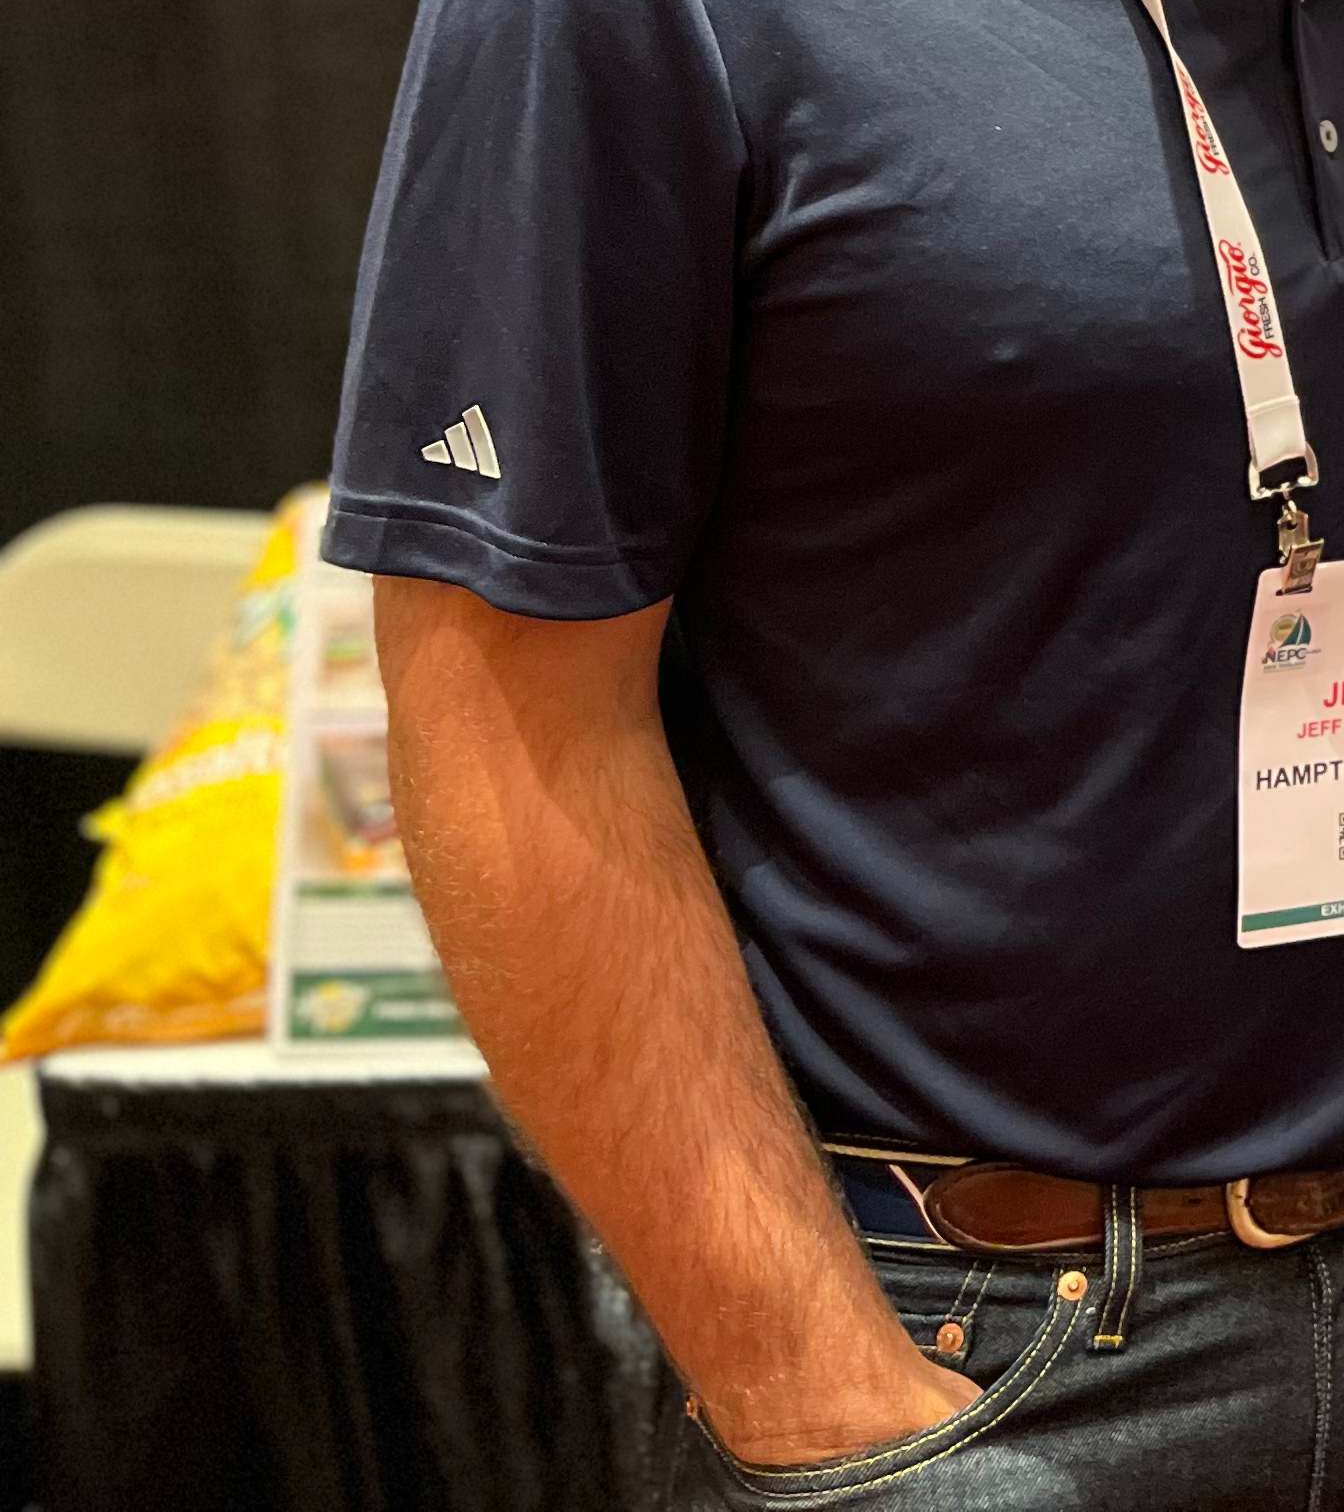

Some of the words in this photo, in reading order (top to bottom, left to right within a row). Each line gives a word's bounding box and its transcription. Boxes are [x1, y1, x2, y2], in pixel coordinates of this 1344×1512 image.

[1219, 239, 1283, 359] Giorgio
[1258, 296, 1275, 340] FRESH
[1297, 719, 1342, 739] JEFF
